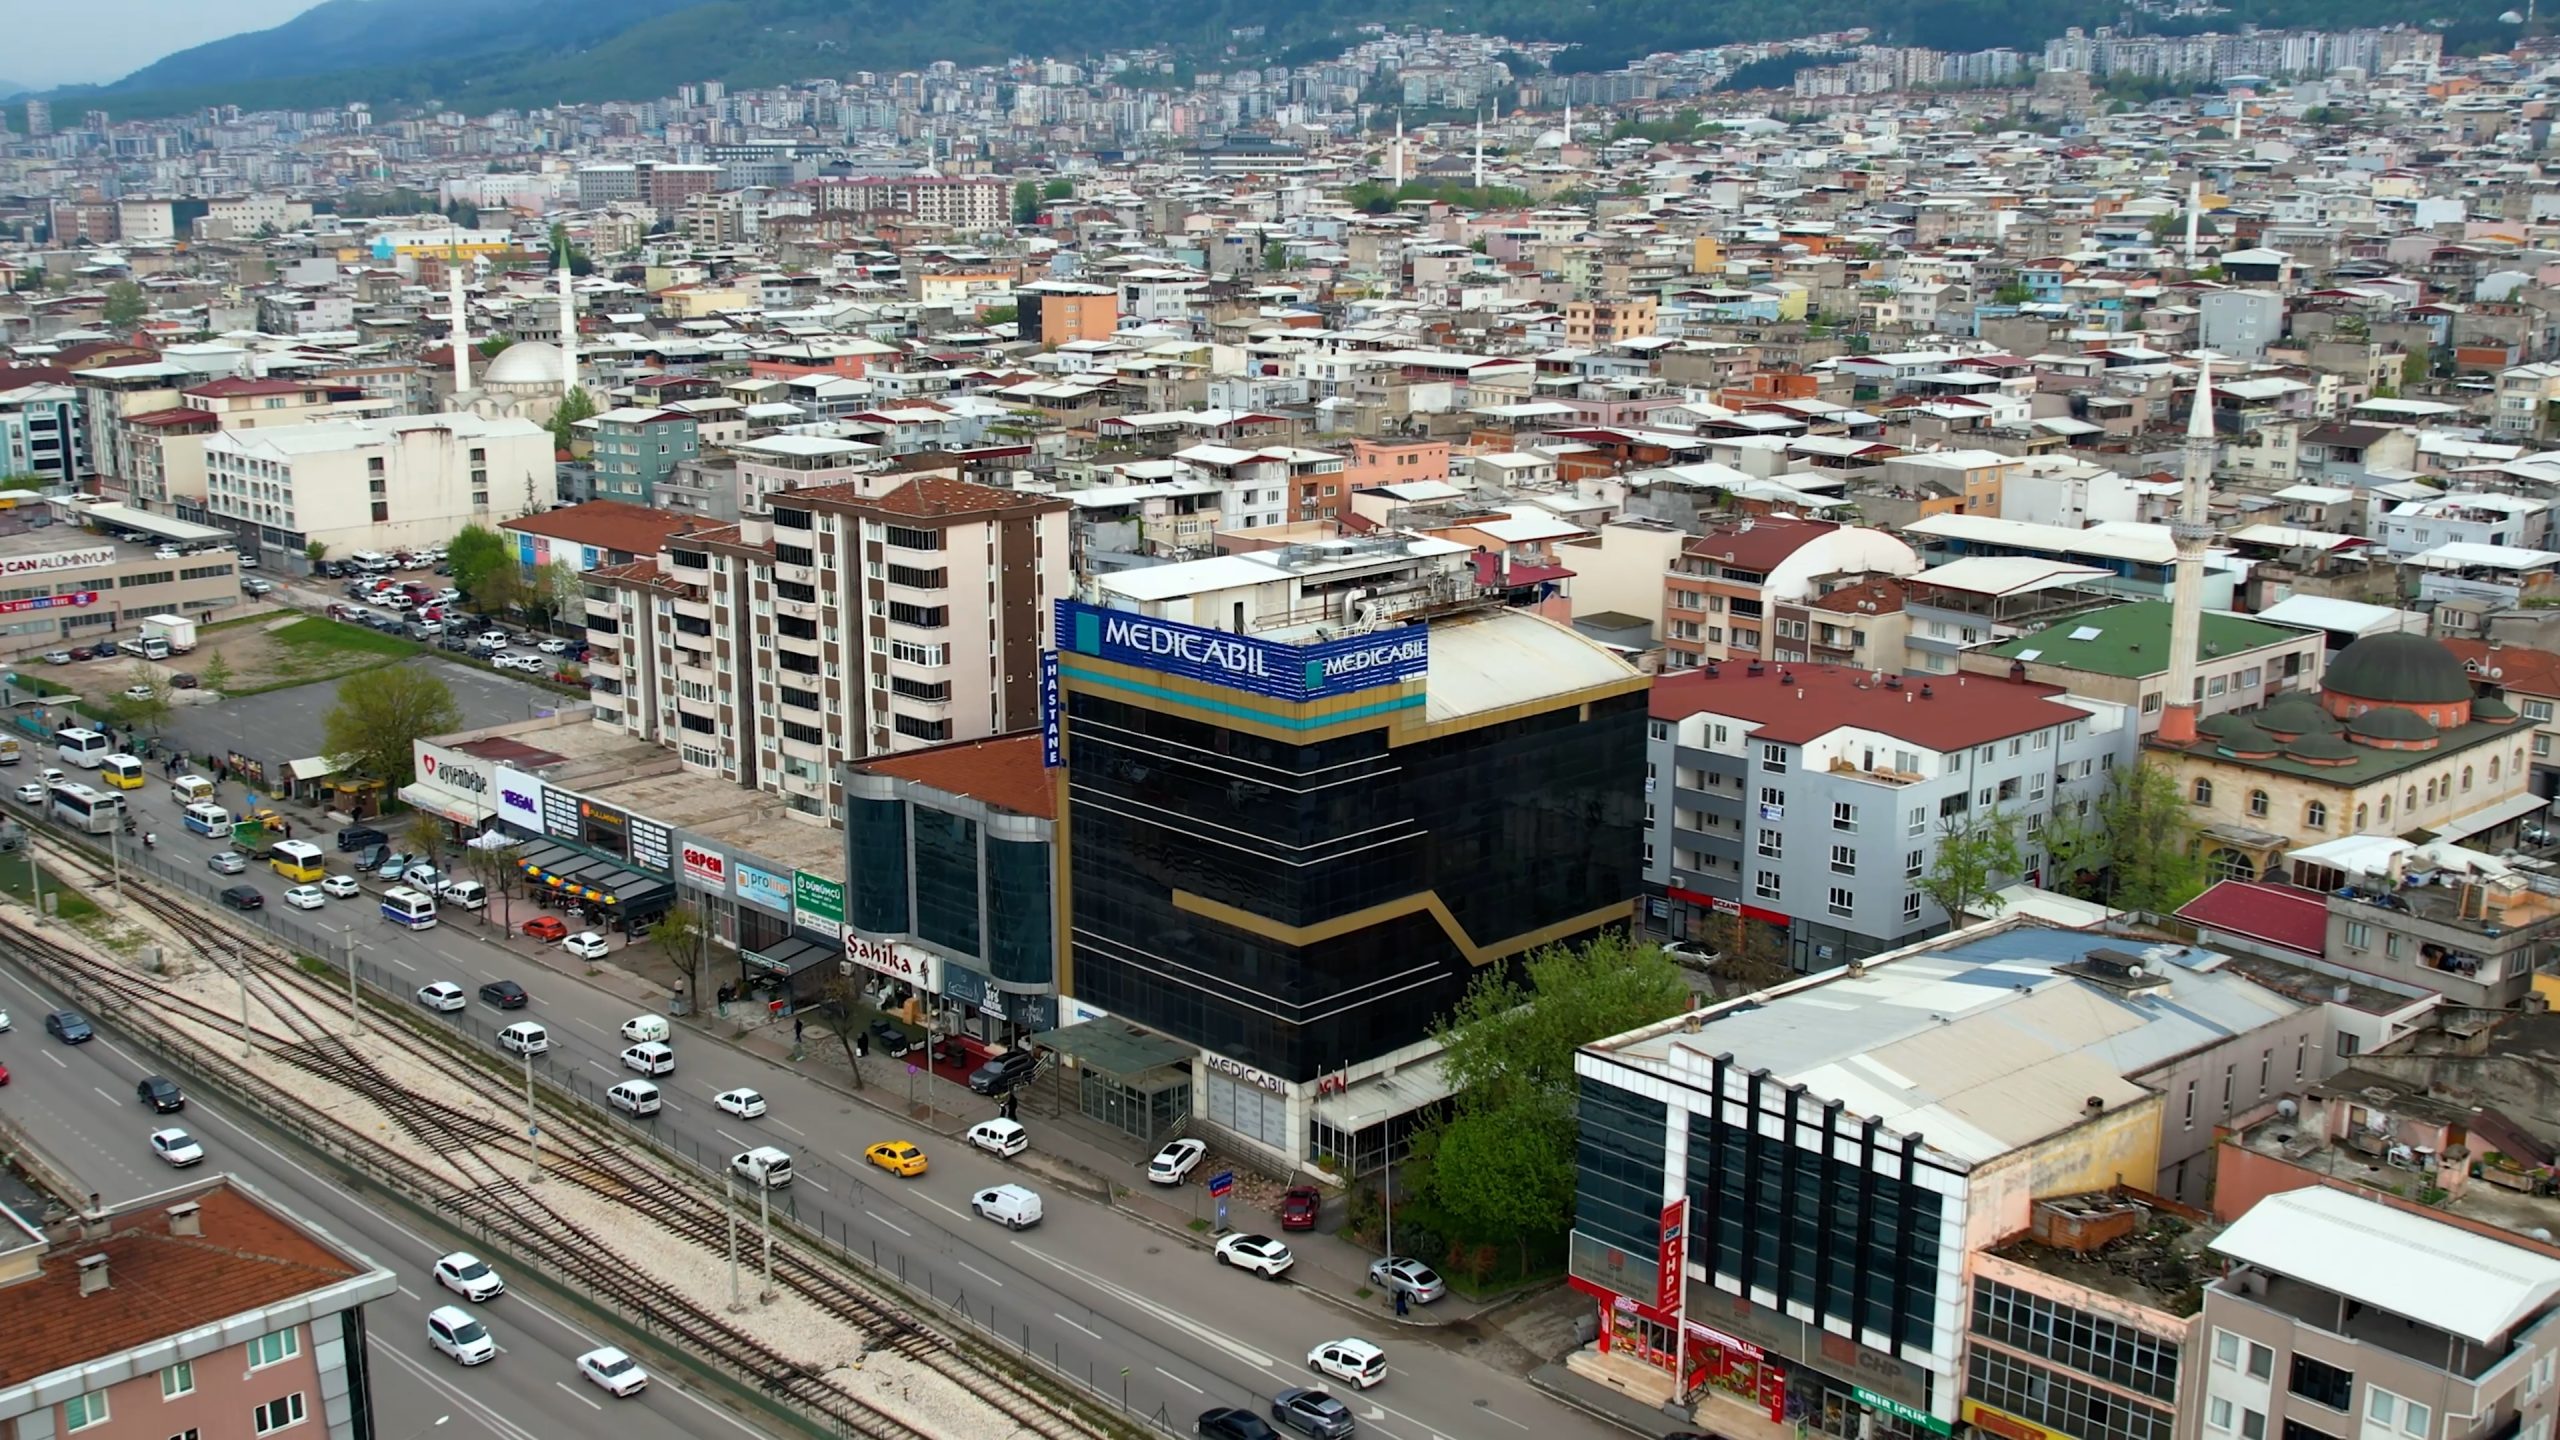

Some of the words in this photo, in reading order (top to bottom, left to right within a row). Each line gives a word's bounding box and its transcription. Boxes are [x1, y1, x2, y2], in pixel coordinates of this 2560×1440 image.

[6, 560, 37, 572] CAN
[1106, 618, 1270, 677] MEDICABIL
[1325, 641, 1426, 676] MEDICABIL
[1047, 664, 1058, 763] HASTANE
[502, 790, 537, 814] REGAL
[684, 849, 722, 874] ERPEN
[806, 880, 841, 900] DÜRÜMCÜ
[847, 933, 912, 974] Şahika
[1208, 1055, 1288, 1096] MEDICABIL
[1220, 1206, 1226, 1216] H
[1666, 1241, 1676, 1290] CHP
[1859, 1352, 1902, 1377] CHP
